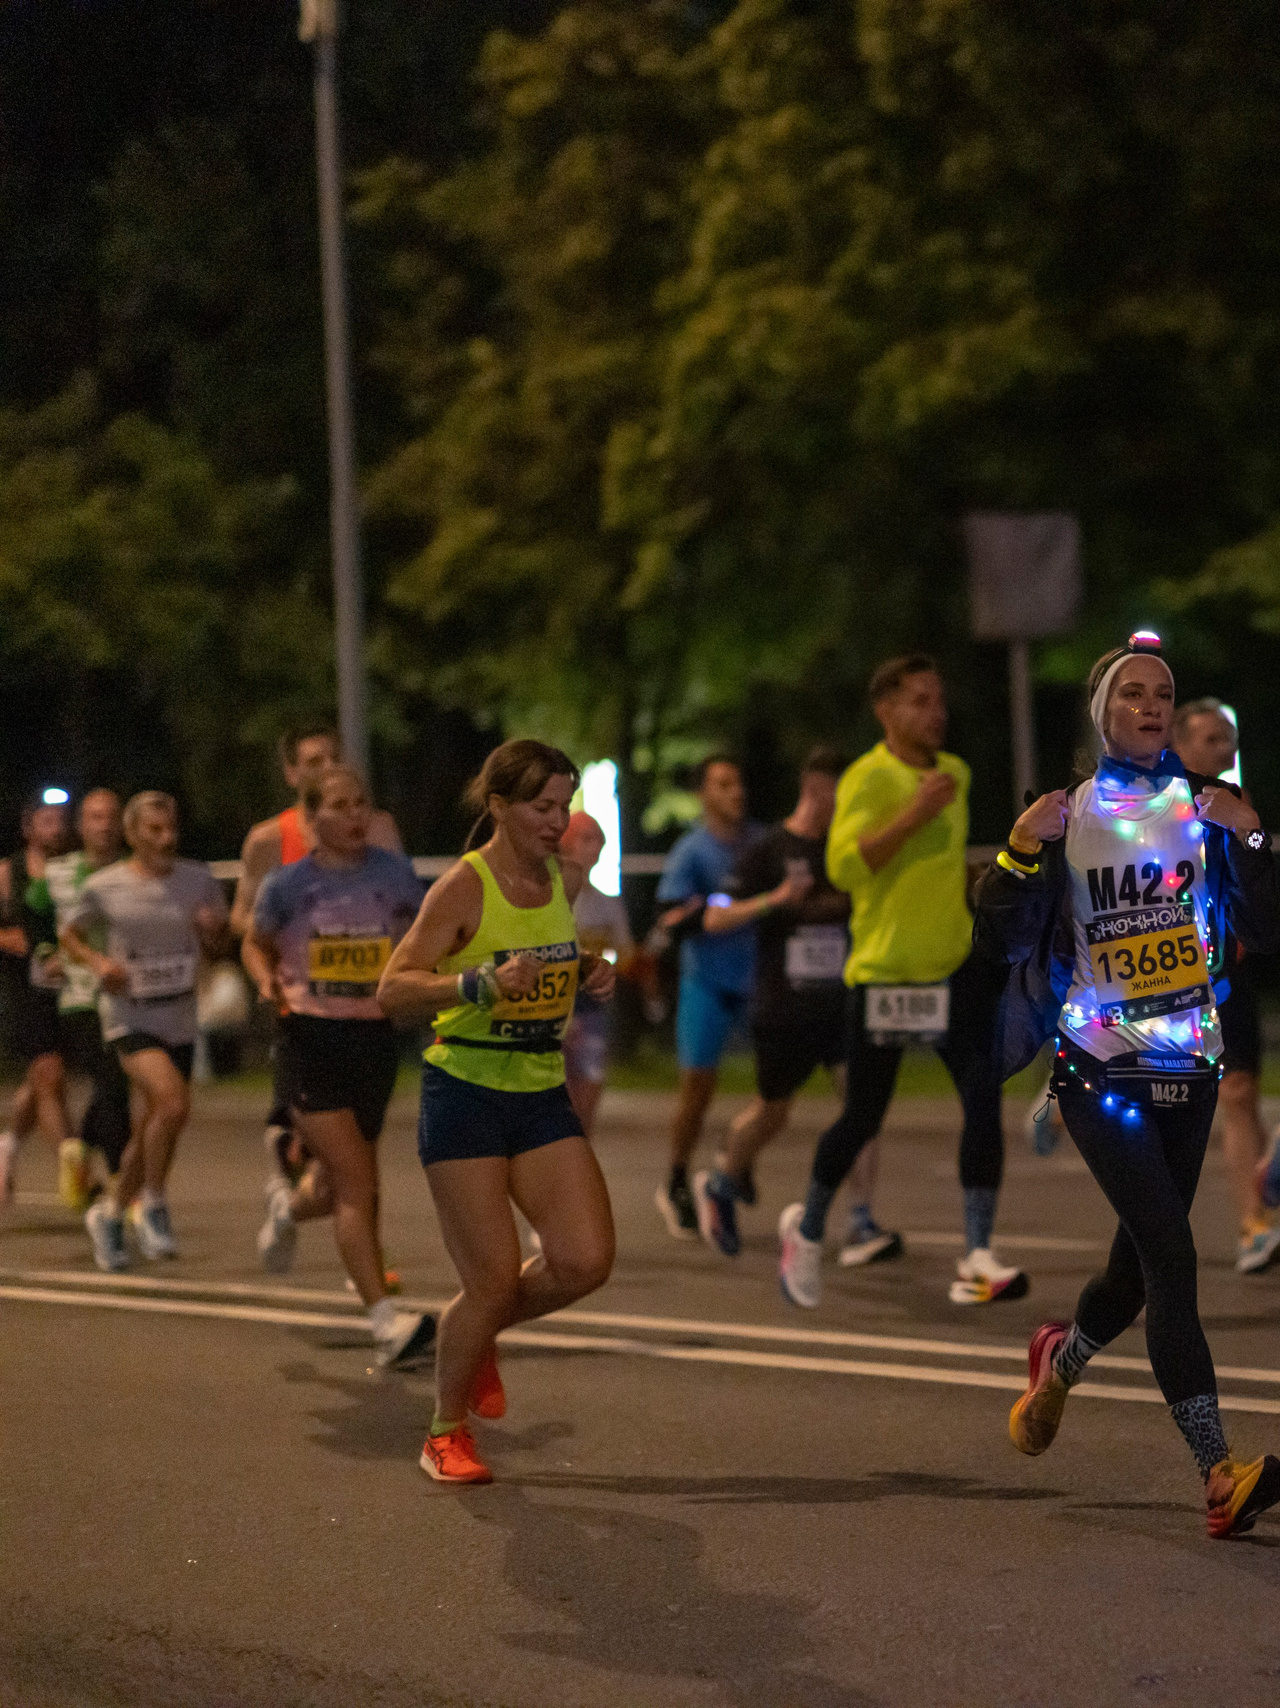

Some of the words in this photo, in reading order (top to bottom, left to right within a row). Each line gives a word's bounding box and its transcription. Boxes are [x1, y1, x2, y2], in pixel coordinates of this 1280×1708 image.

[1087, 860, 1195, 912] M42.2
[1098, 934, 1198, 984] 13685
[1131, 975, 1171, 992] ЖАННА
[1164, 1058, 1197, 1069] MARATHON
[1151, 1082, 1189, 1103] M42.2
